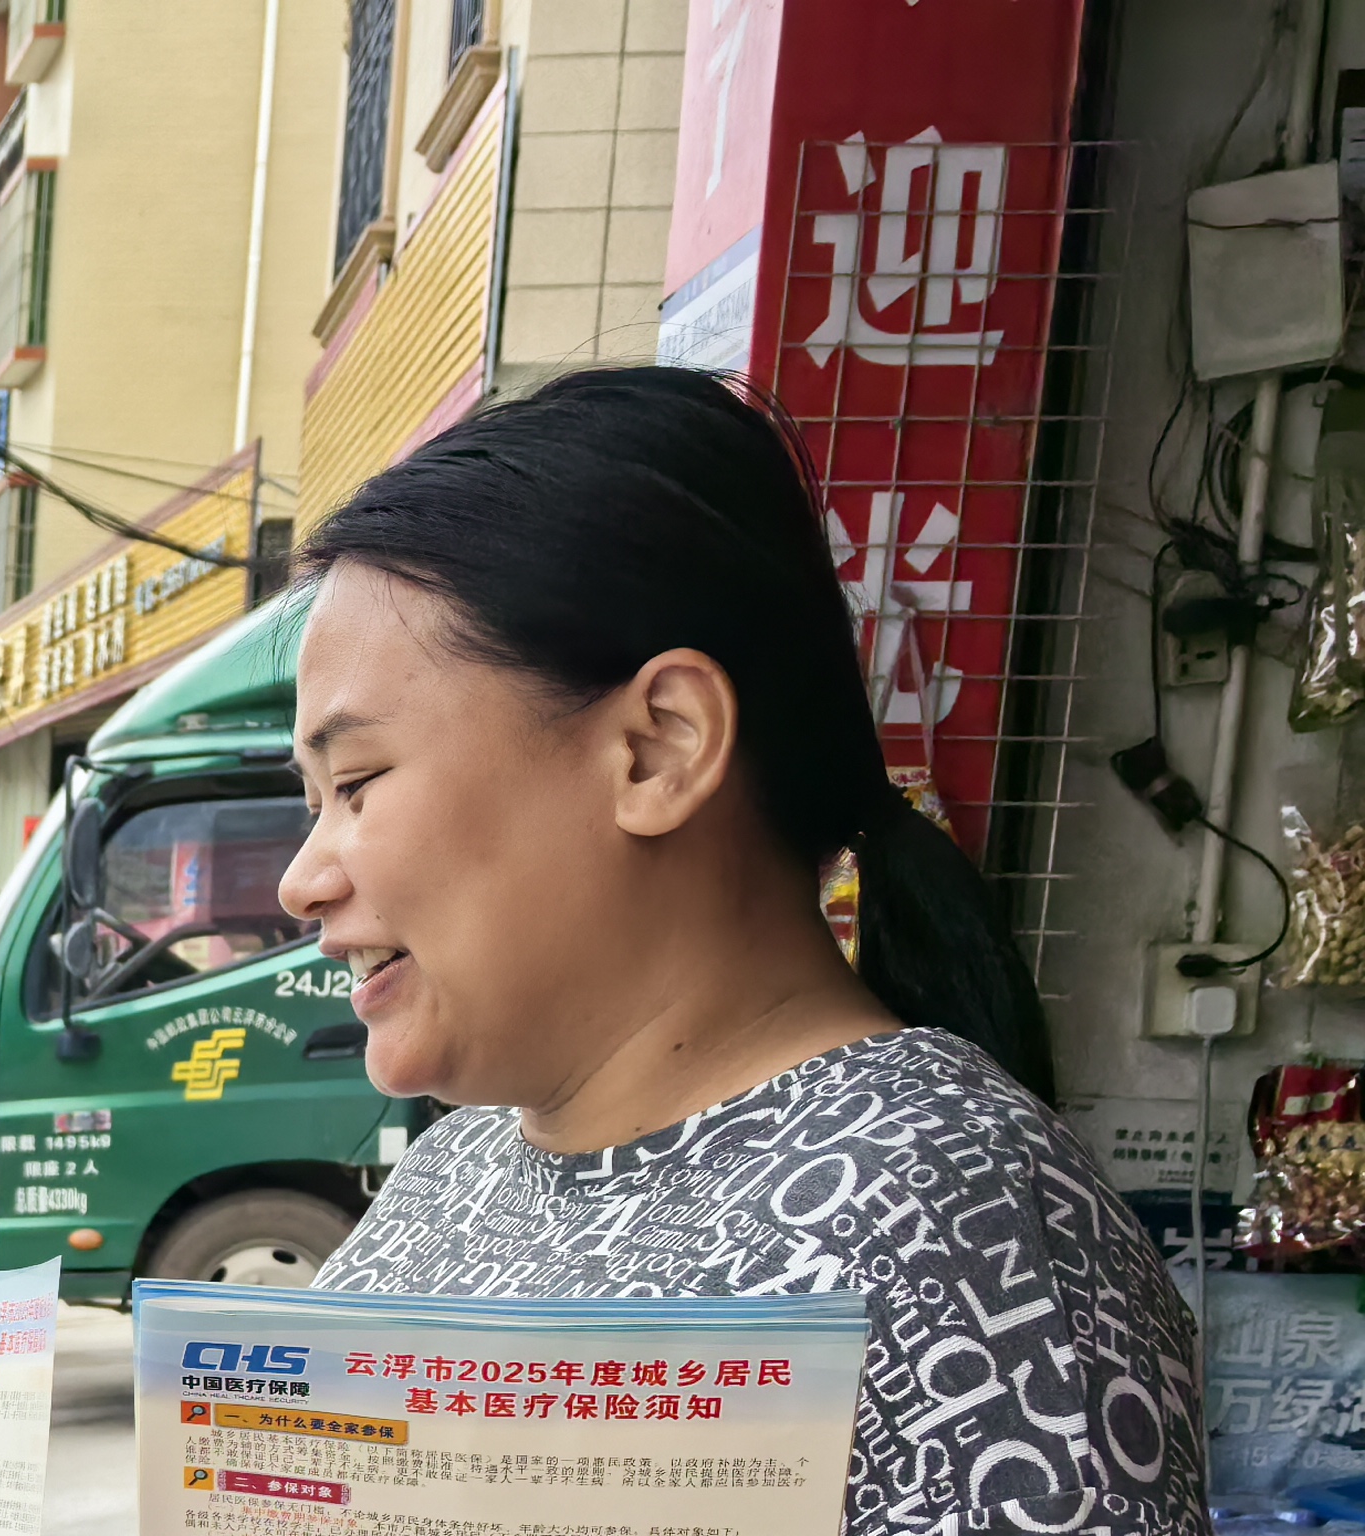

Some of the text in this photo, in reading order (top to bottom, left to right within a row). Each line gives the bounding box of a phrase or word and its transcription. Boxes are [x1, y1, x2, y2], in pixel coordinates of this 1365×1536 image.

[274, 969, 354, 998] 24J2
[0, 1136, 36, 1153] 限载
[181, 1341, 311, 1375] CHS
[344, 1352, 794, 1388] 云浮市2025年度城乡居民
[181, 1374, 311, 1398] 中国医疗保障
[404, 1387, 724, 1421] 基本医疗保险须知
[223, 1412, 395, 1440] 一、为什么要全家参保
[234, 1476, 334, 1500] 二、参保对象
